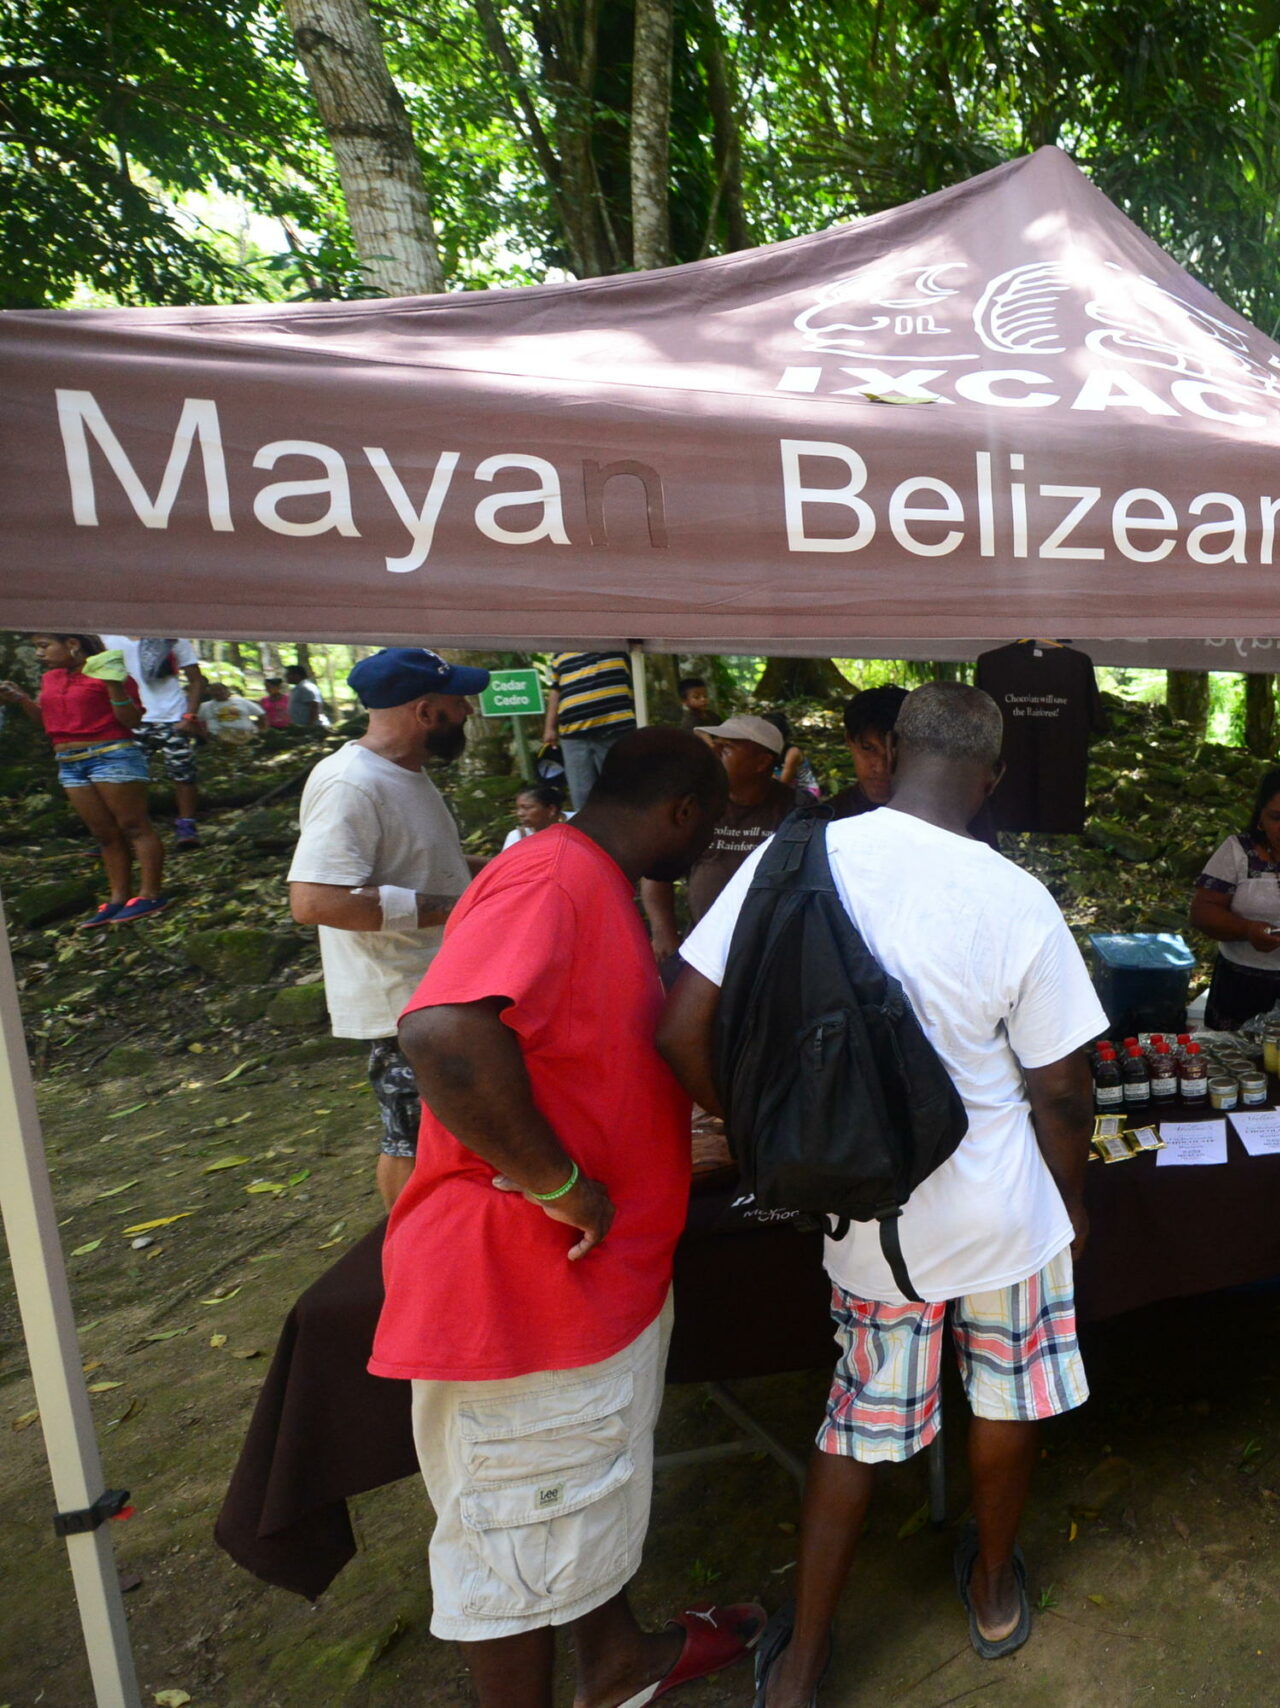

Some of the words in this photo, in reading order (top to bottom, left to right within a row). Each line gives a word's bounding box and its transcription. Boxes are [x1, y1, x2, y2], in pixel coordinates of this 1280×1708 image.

[54, 388, 669, 574] Mayan
[493, 681, 526, 691] Cedar
[494, 696, 529, 705] Cedro
[1040, 694, 1054, 704] will
[1013, 707, 1026, 717] the
[743, 826, 761, 837] will
[541, 1489, 558, 1500] Lee
